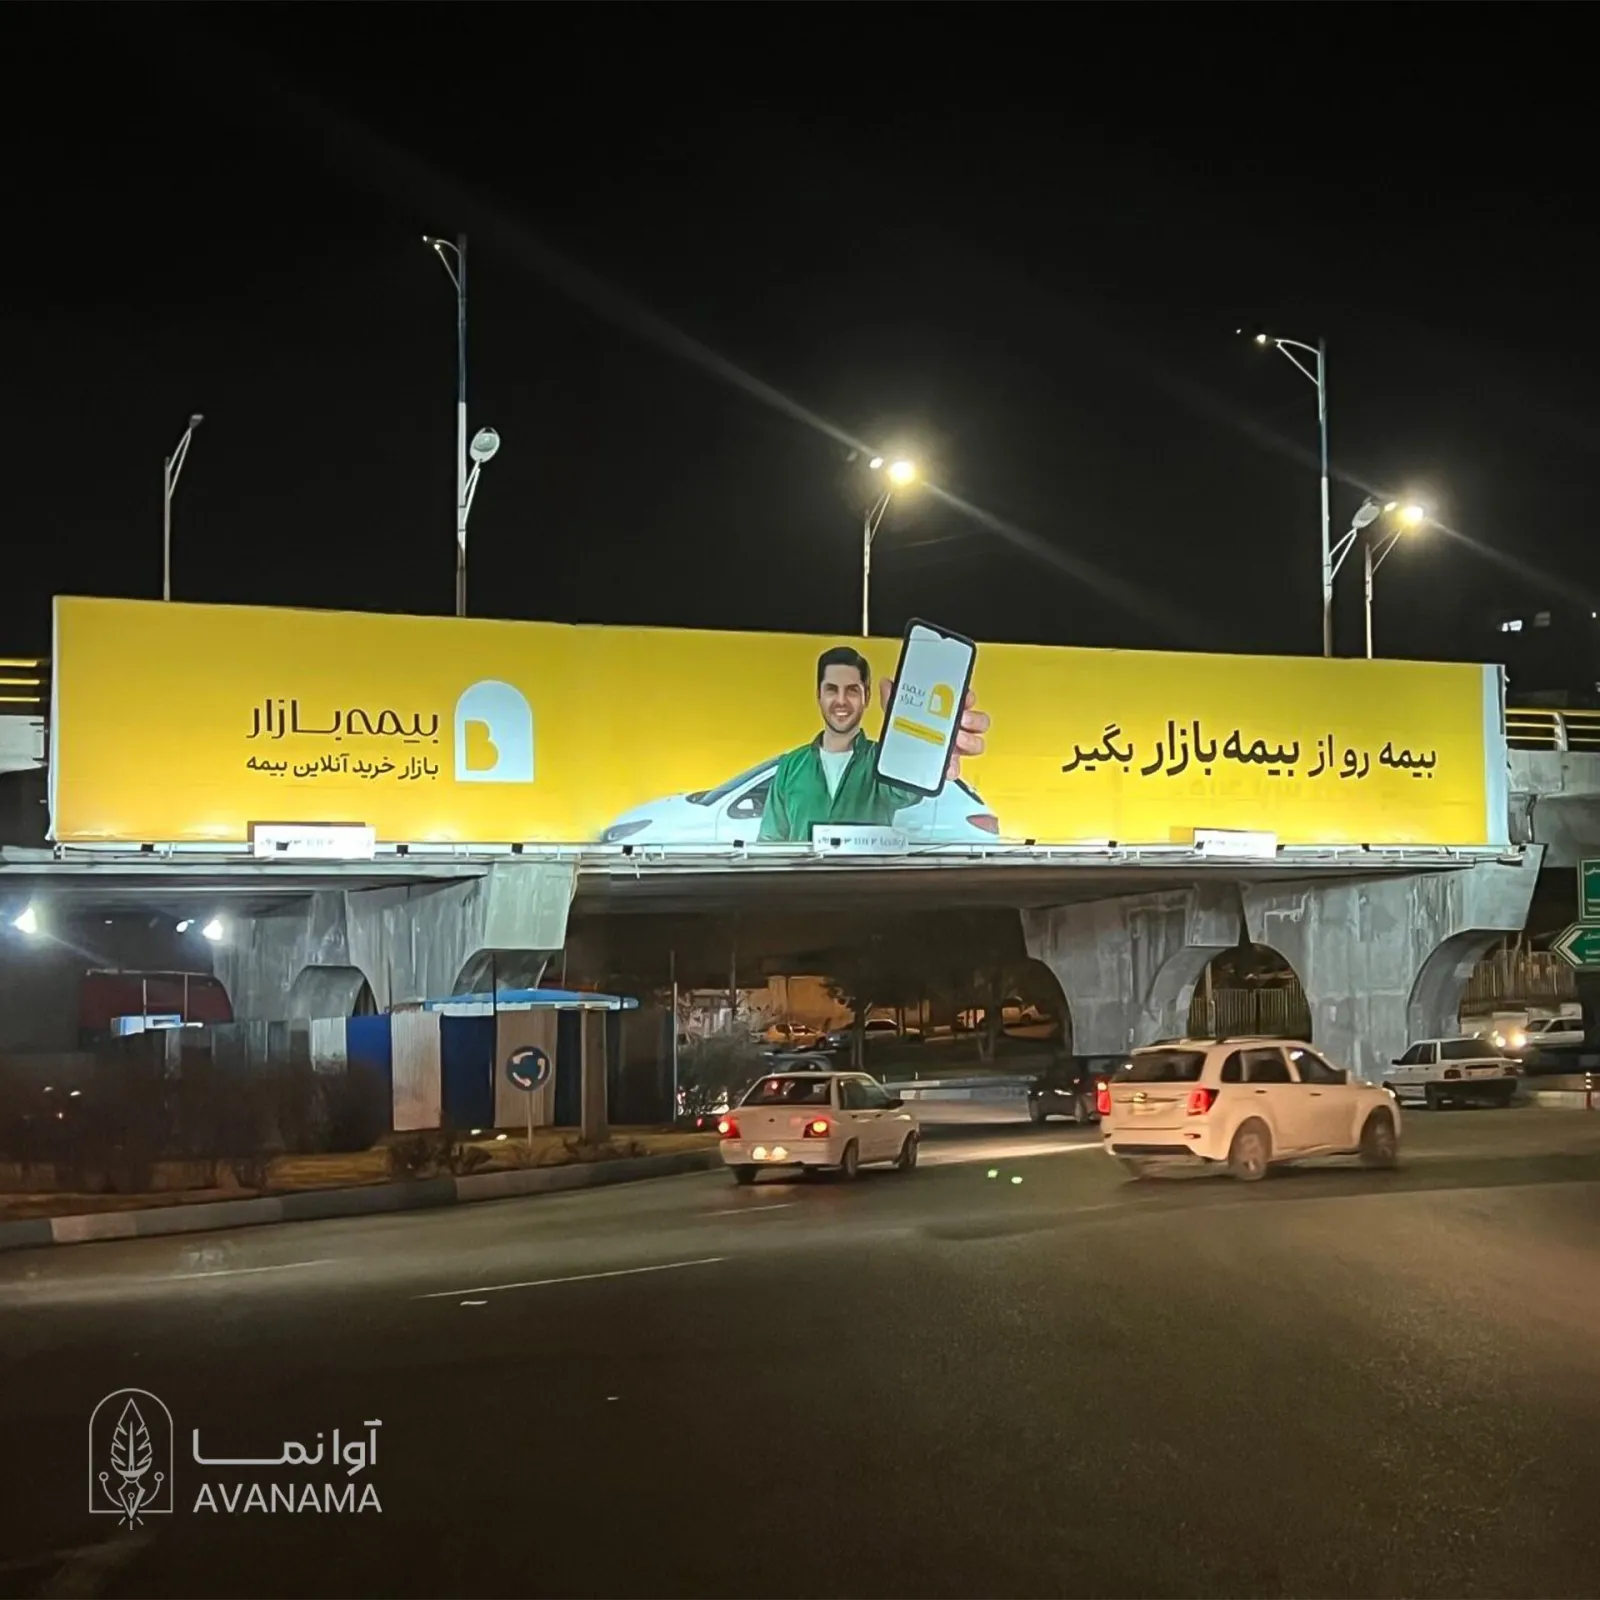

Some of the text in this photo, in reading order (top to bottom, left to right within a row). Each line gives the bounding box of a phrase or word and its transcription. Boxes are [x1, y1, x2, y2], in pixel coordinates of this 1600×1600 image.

[246, 752, 439, 780] بازار خرید آنلاین بیمه
[1062, 723, 1134, 773] بگیر
[1307, 734, 1334, 778] از
[1339, 748, 1370, 779] رو
[1378, 741, 1437, 779] بیمه
